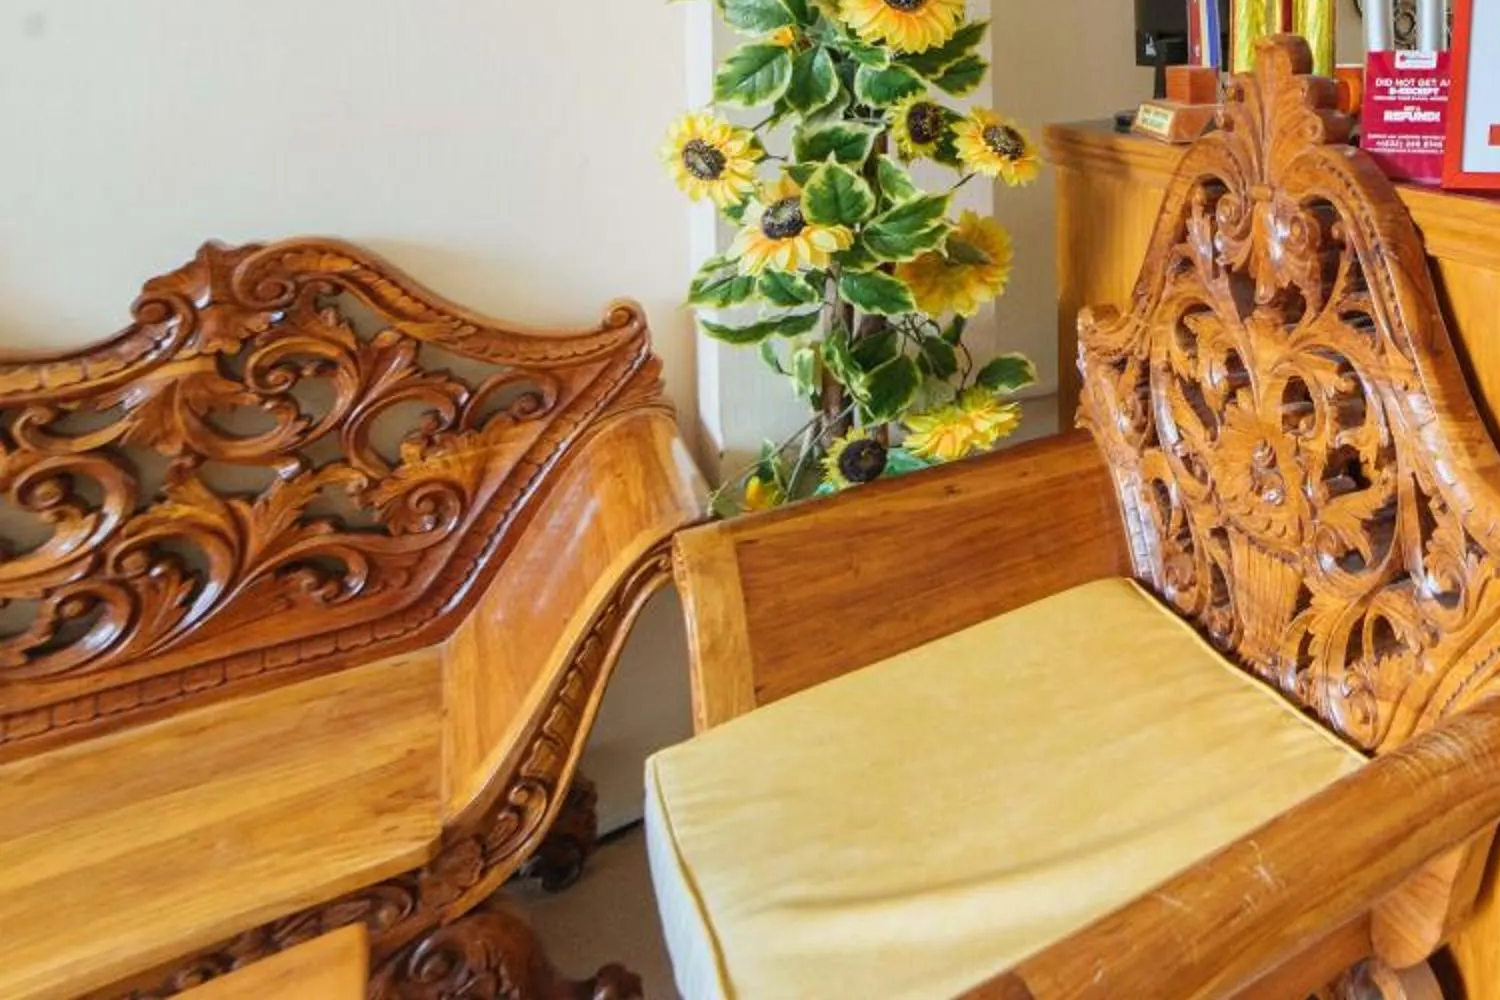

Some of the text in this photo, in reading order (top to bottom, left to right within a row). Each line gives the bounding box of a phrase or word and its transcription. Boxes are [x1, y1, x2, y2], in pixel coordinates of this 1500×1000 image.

[1375, 78, 1392, 87] DID
[1395, 78, 1415, 87] NOT
[1418, 78, 1437, 88] GET
